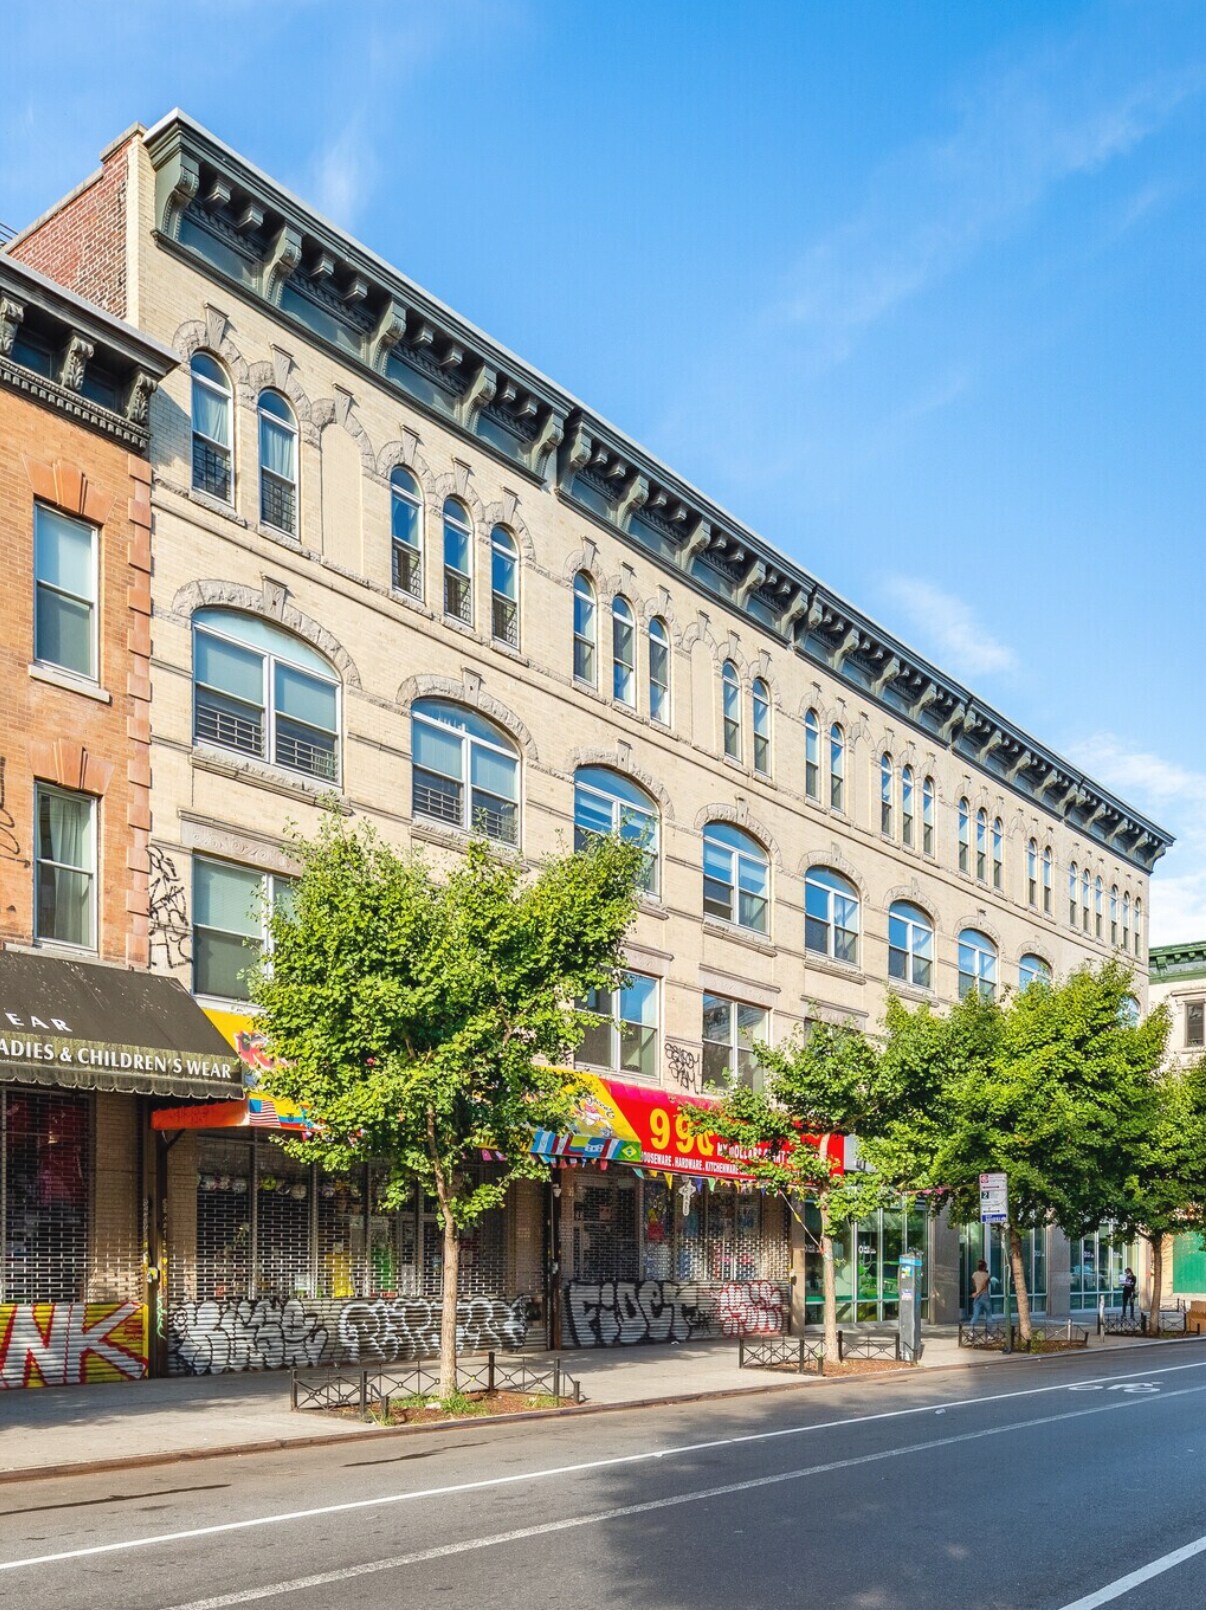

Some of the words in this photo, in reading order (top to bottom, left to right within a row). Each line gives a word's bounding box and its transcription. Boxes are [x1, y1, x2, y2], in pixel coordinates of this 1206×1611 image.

[5, 1012, 73, 1032] EAR
[60, 1046, 72, 1062] &
[77, 1047, 182, 1074] CHILDREN'S
[186, 1059, 232, 1079] WEAR
